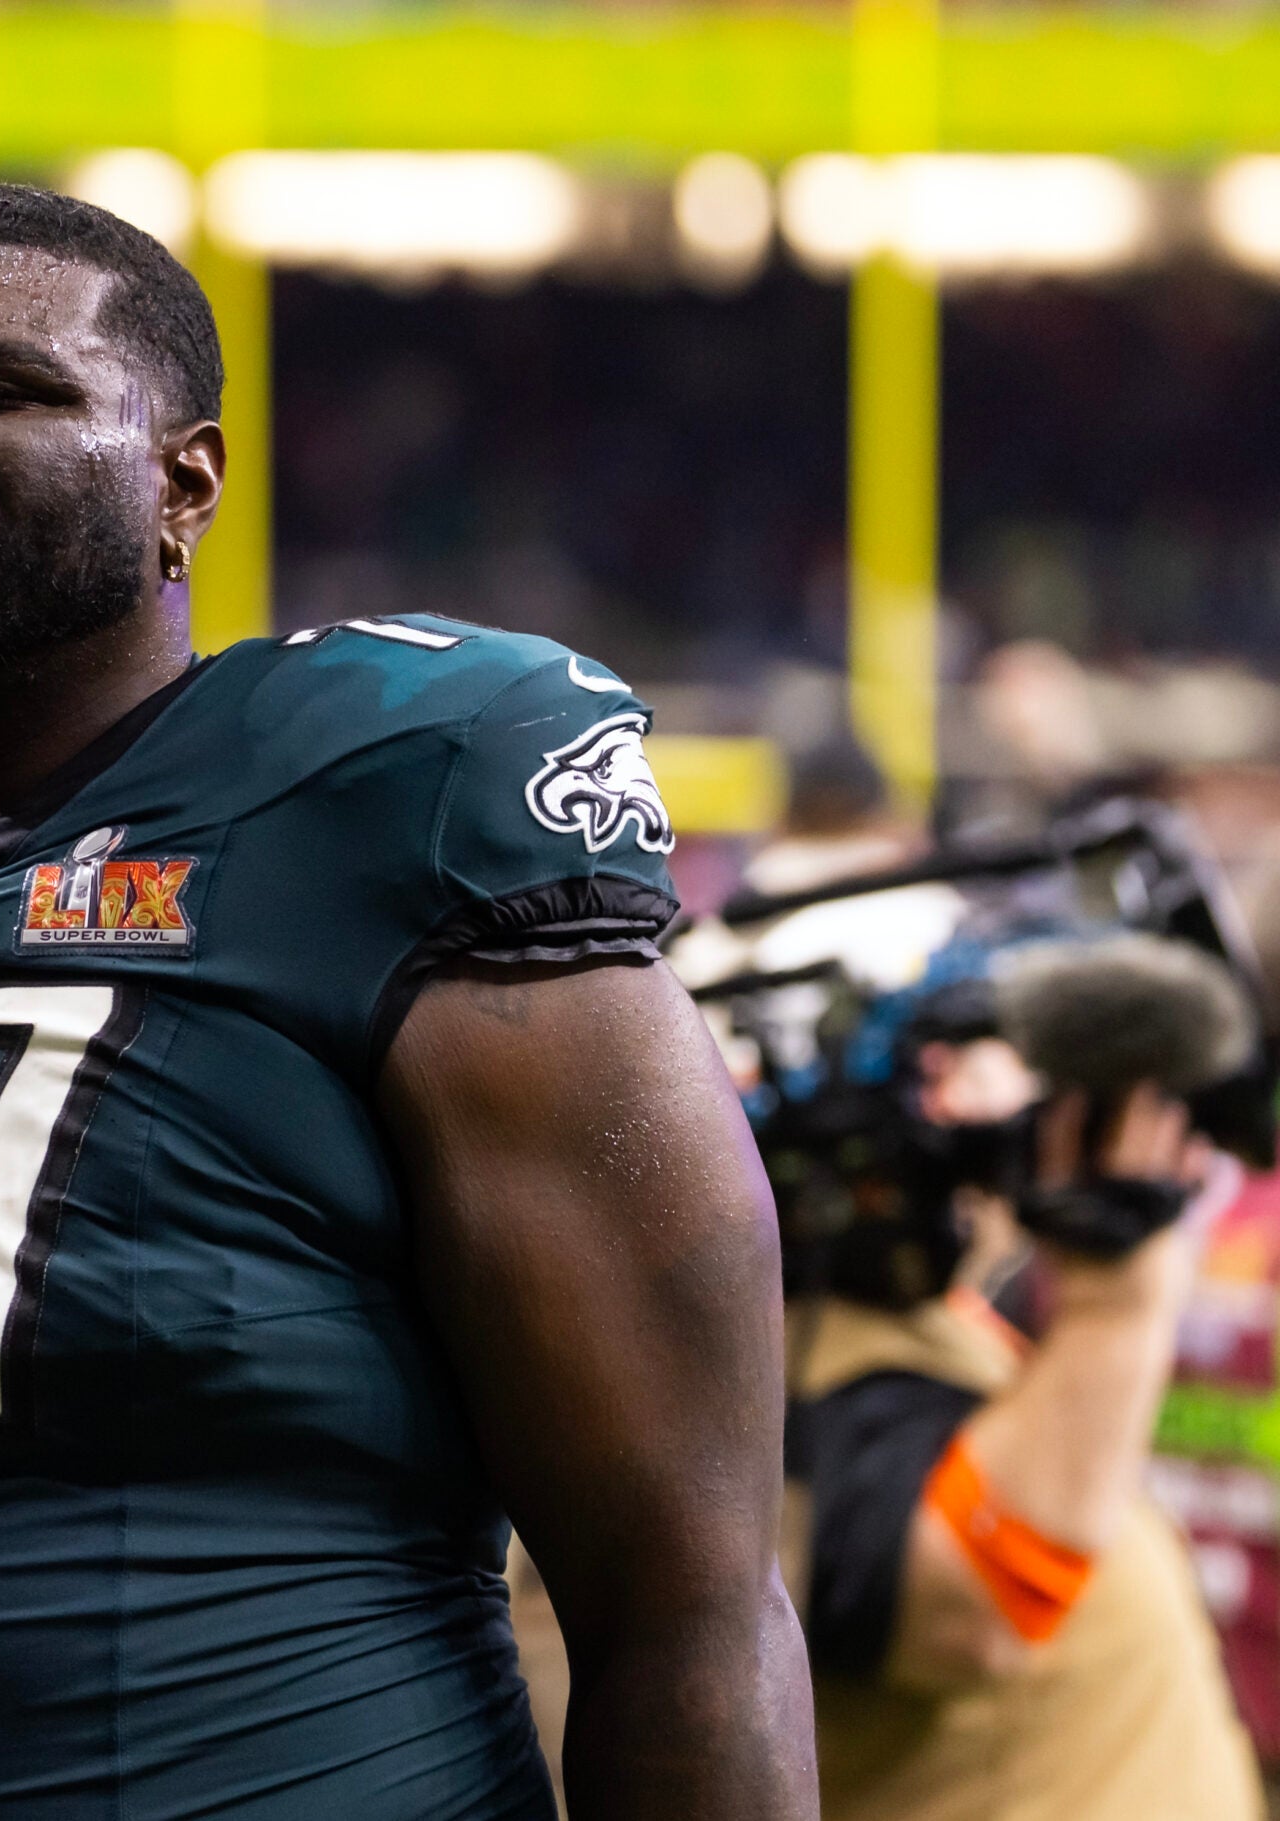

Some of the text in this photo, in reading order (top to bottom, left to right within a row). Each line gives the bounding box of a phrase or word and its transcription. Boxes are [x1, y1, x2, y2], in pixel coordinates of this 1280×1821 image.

[26, 861, 193, 929] LIX
[40, 930, 170, 942] SUPER BOWL
